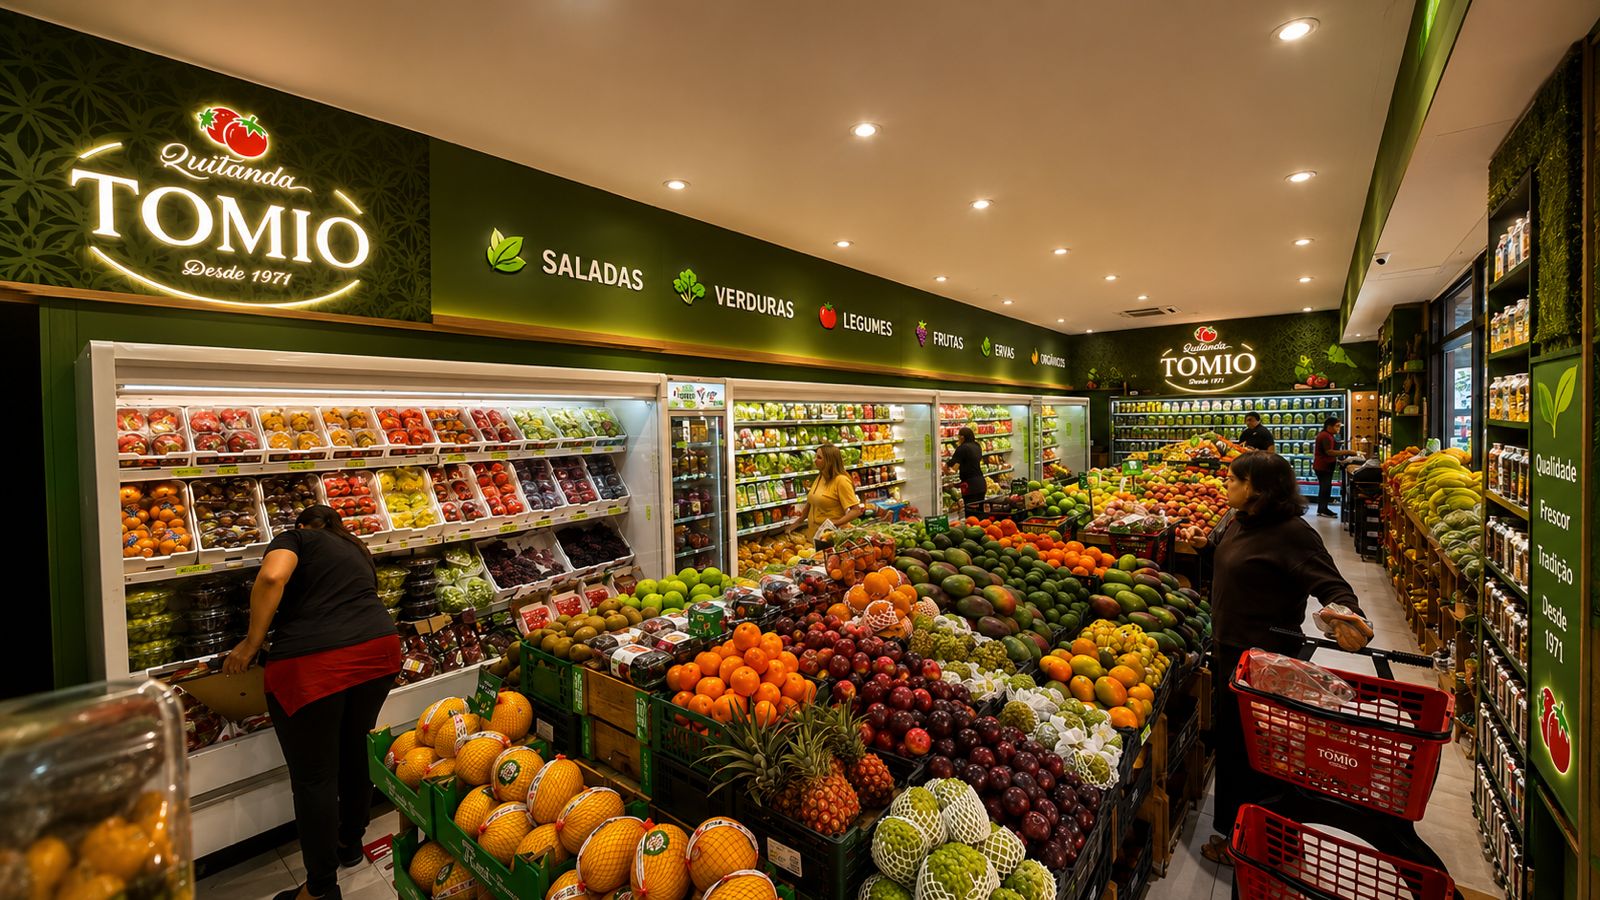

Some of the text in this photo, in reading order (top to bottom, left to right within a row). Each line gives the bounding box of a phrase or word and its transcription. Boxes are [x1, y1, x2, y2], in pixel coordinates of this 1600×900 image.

[160, 143, 312, 192] Quitanda
[72, 168, 370, 269] TOMIO
[182, 259, 293, 286] Desde 1971
[542, 249, 644, 292] SALADAS
[715, 285, 795, 319] VERDURAS
[843, 312, 893, 337] LEGUMES
[933, 331, 964, 350] FRUTAS
[994, 343, 1015, 359] ERVAS
[1183, 341, 1233, 355] Quitanda
[1160, 352, 1257, 377] TOMIO
[1535, 453, 1577, 484] Qualidade
[1540, 499, 1571, 531] Frescor
[1537, 544, 1574, 587] Tradição
[1542, 594, 1568, 632] Desde
[1545, 629, 1564, 665] 1971
[1317, 748, 1358, 768] TOMIO
